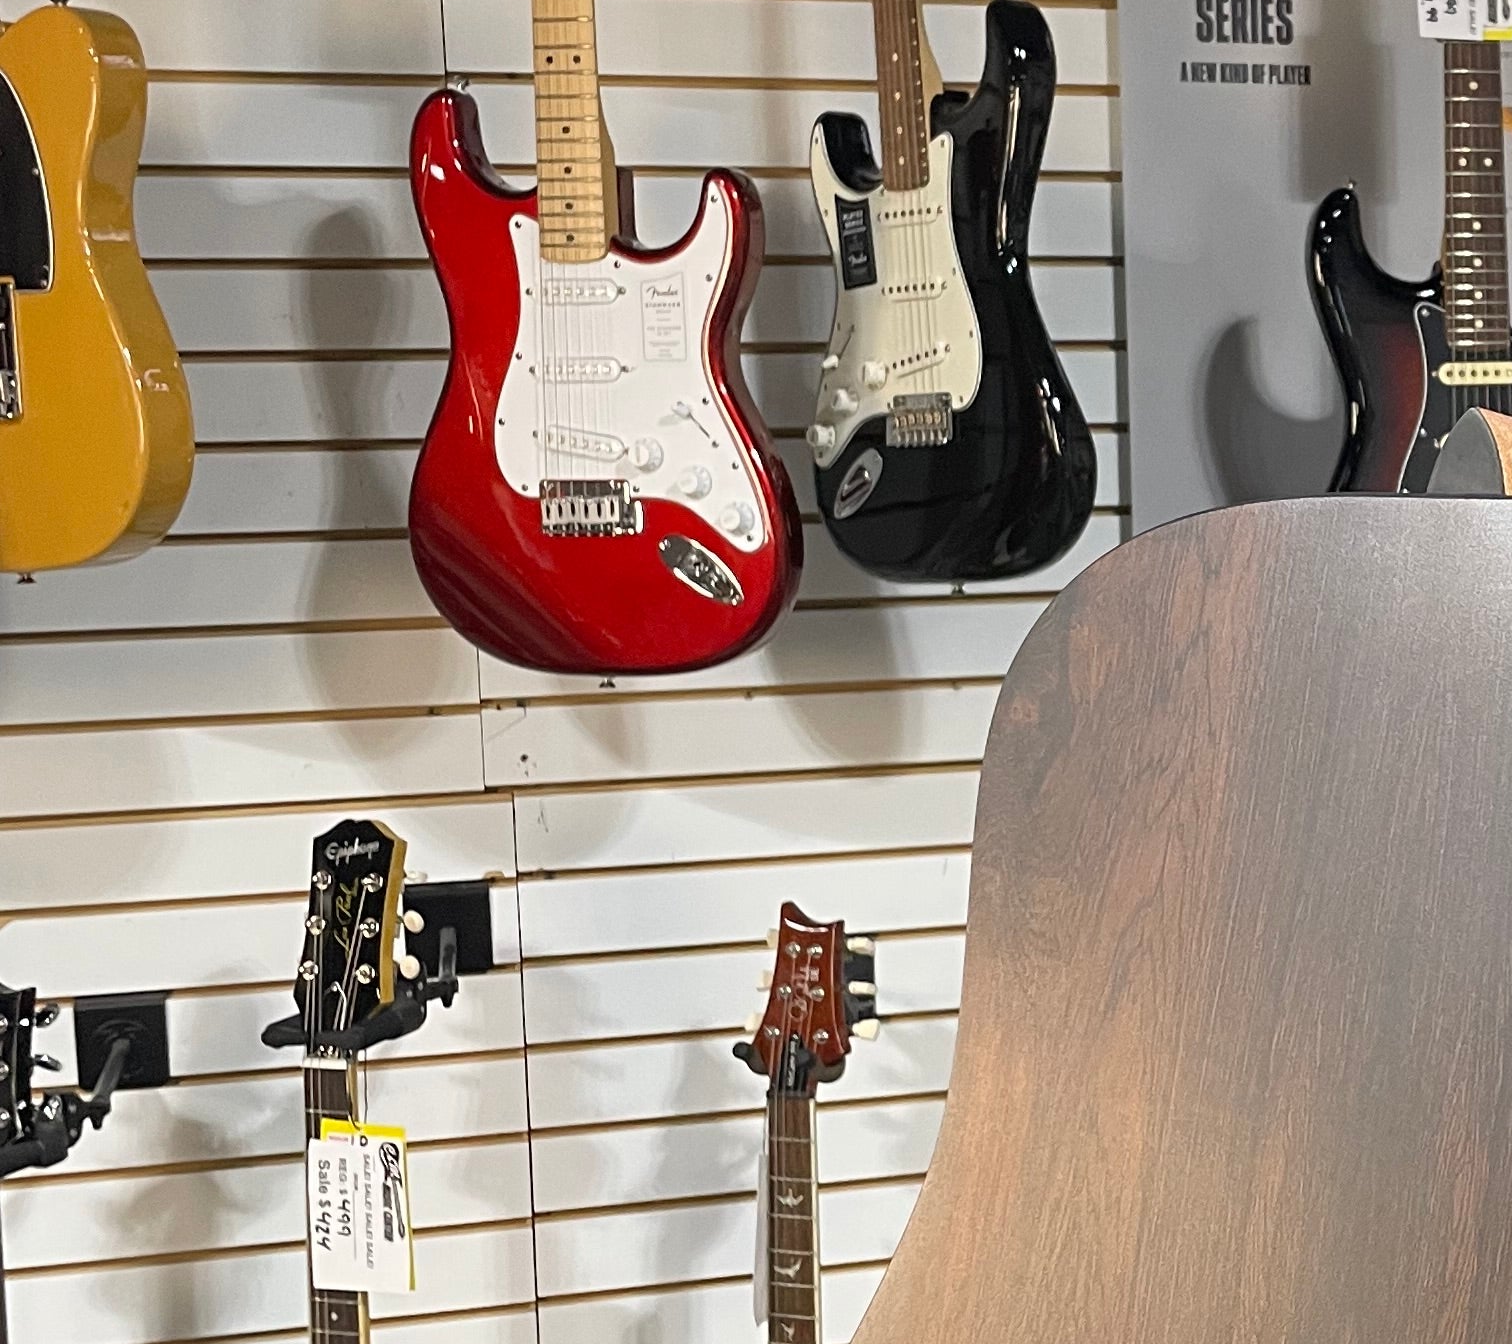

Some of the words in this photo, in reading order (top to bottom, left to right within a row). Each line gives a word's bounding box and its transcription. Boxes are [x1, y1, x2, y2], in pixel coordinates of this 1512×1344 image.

[1180, 62, 1189, 82] A
[1191, 62, 1217, 83] NEW
[1220, 63, 1248, 83] KIND
[1252, 64, 1266, 84] OF
[1269, 64, 1311, 85] PLAYER
[325, 837, 380, 866] Epiphone
[318, 1160, 331, 1194] Sale
[337, 1199, 351, 1237] 499
